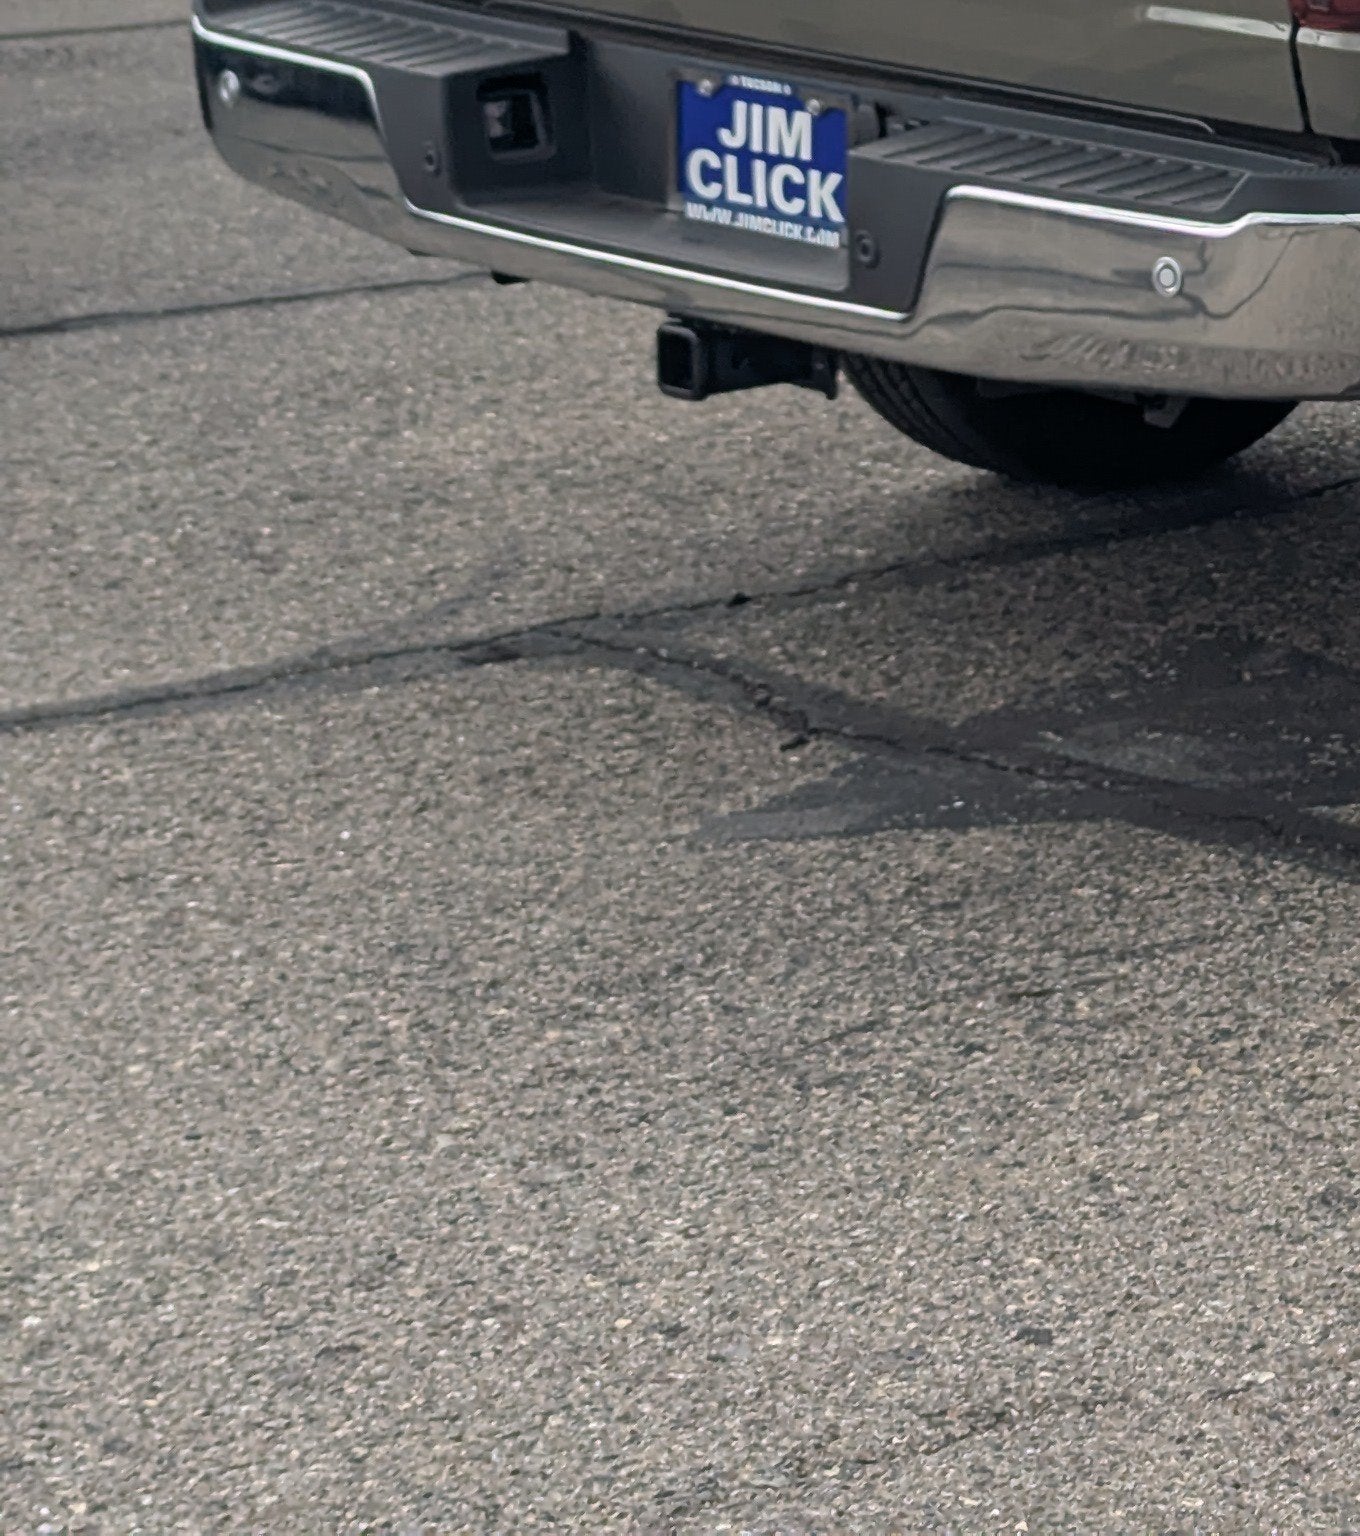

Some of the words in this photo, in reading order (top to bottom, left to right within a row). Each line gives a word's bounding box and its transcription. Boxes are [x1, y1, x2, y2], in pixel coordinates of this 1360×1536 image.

[716, 98, 813, 162] JIM
[685, 147, 846, 224] CLICK
[684, 201, 842, 249] WWW.JIMCLICK.COM
